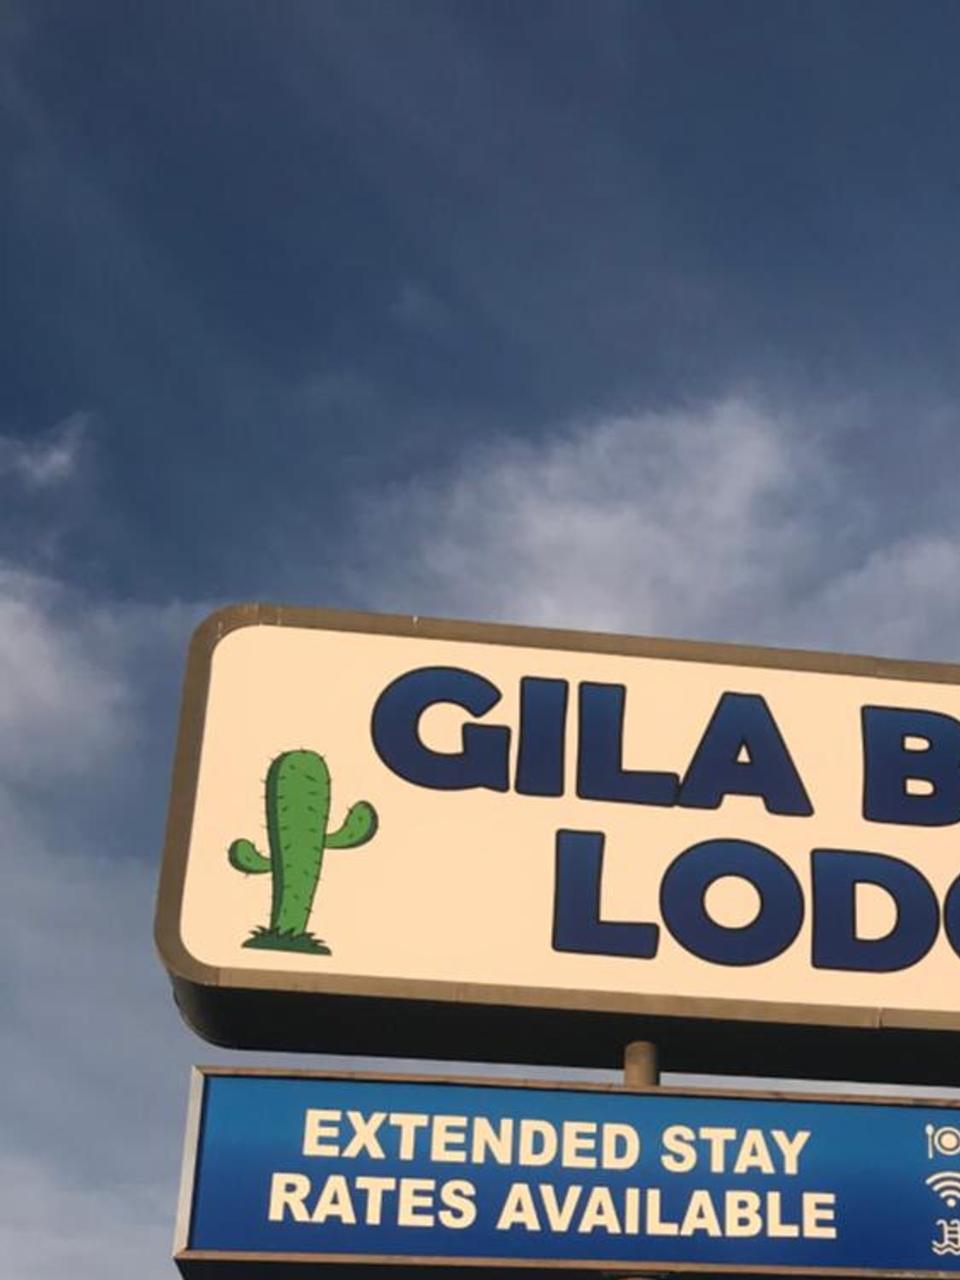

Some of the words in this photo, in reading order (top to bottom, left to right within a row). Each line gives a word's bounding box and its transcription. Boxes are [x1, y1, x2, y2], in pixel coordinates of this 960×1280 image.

[371, 665, 814, 817] GILA
[302, 1108, 641, 1171] EXTENDED
[660, 1124, 811, 1175] STAY
[267, 1172, 477, 1229] RATES
[497, 1183, 838, 1240] AVAILABLE
